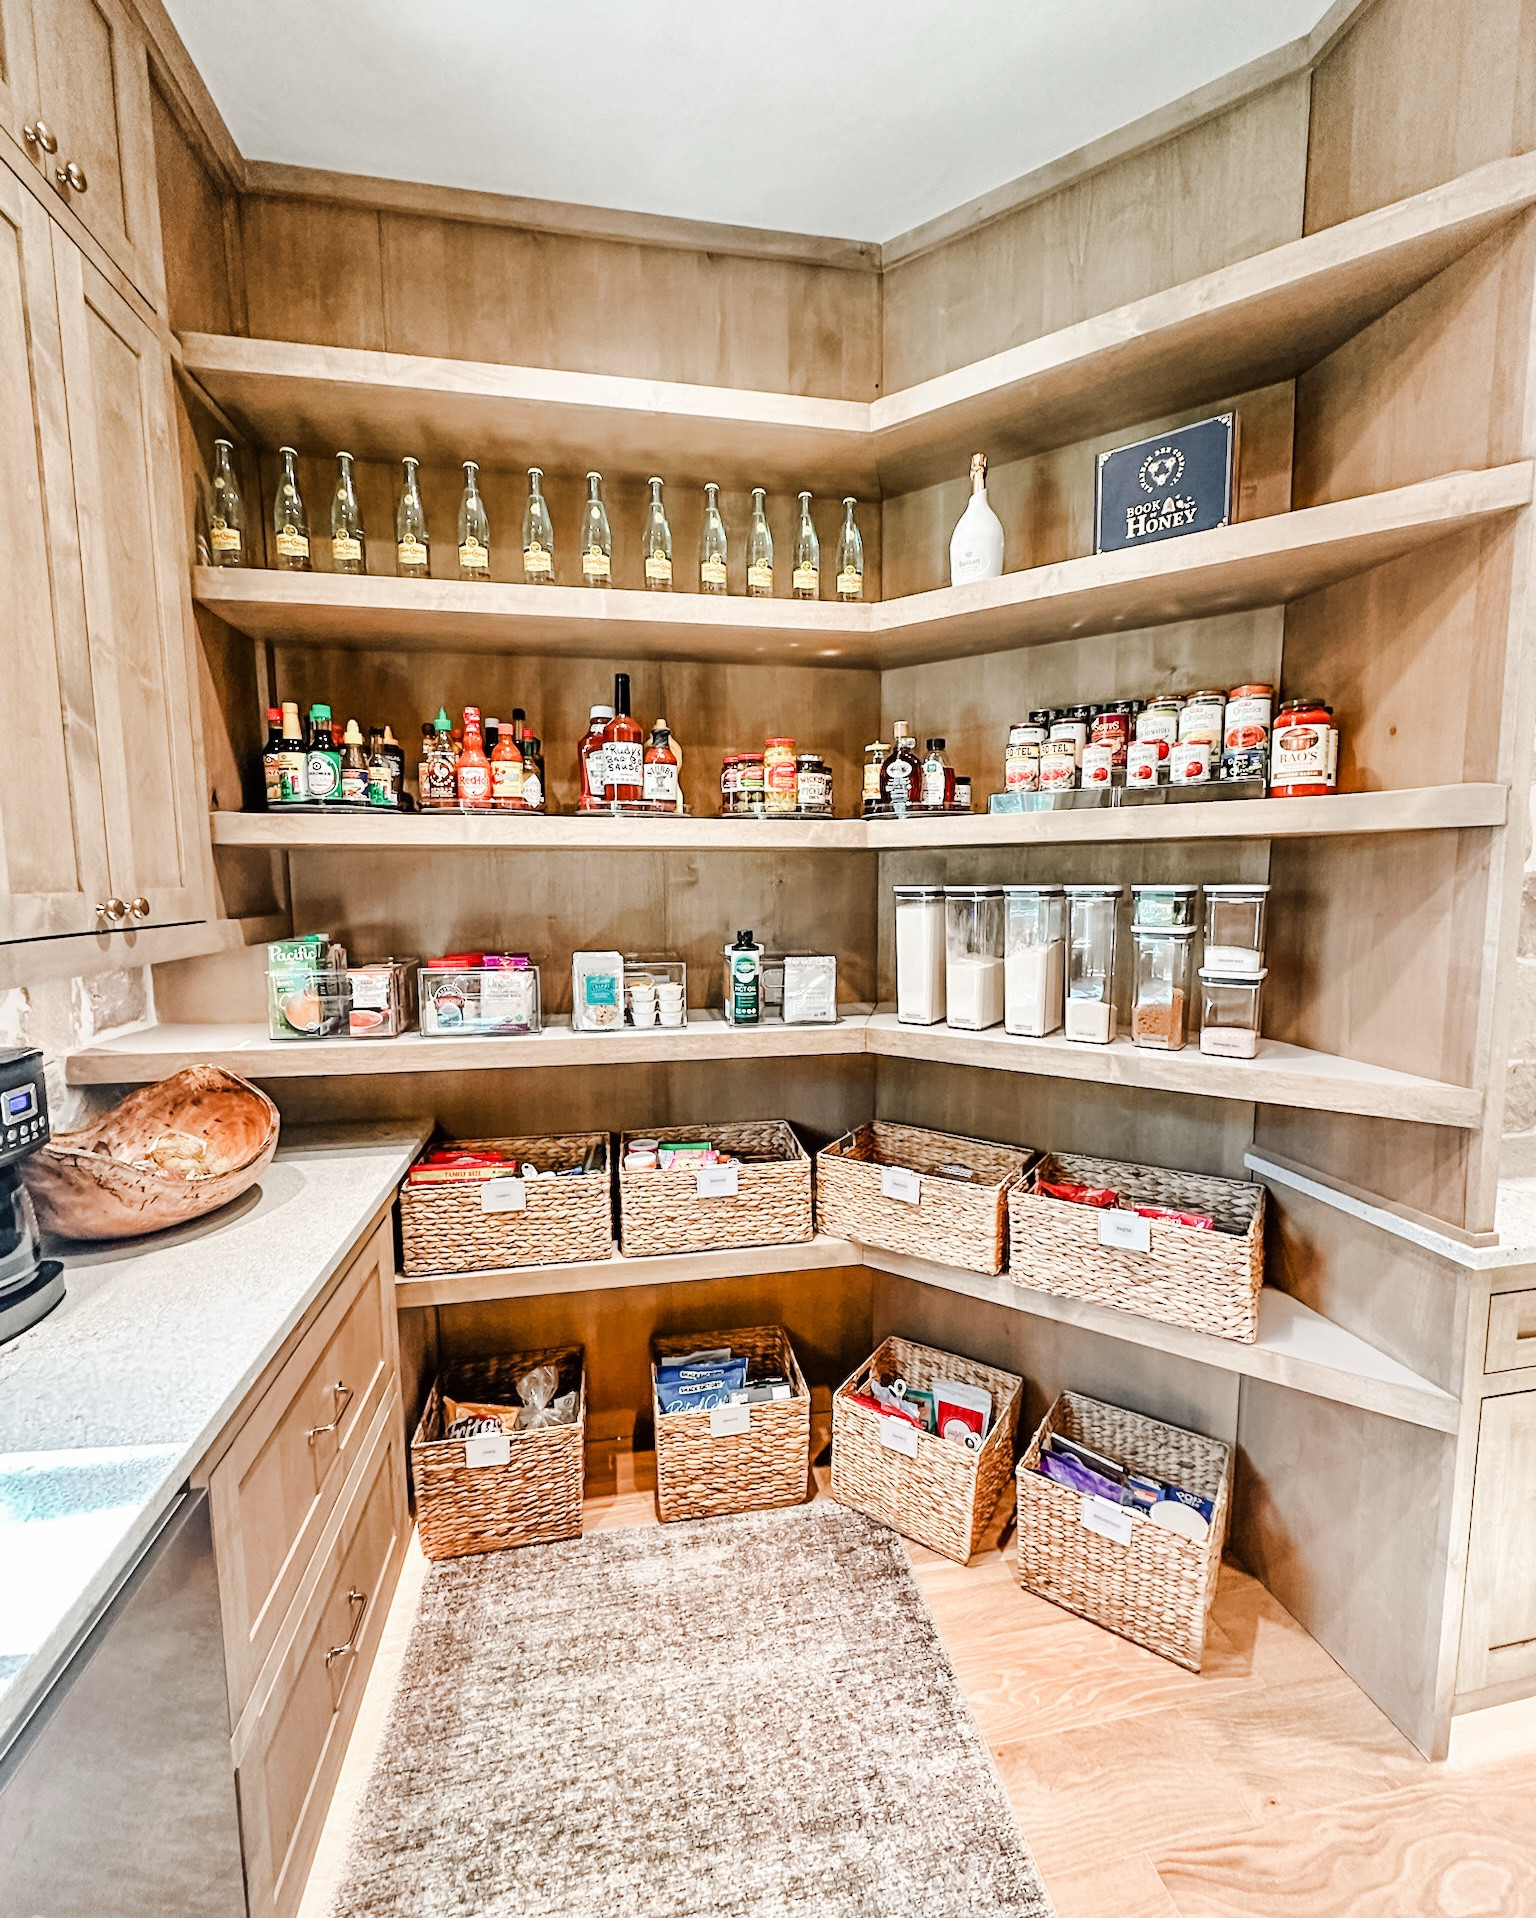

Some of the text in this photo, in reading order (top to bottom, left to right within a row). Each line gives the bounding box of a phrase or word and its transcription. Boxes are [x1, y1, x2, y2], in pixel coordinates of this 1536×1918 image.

[1126, 500, 1160, 518] BOOK
[1125, 507, 1198, 539] HONEY
[1280, 752, 1318, 764] RAO'S
[269, 945, 317, 962] Pacific
